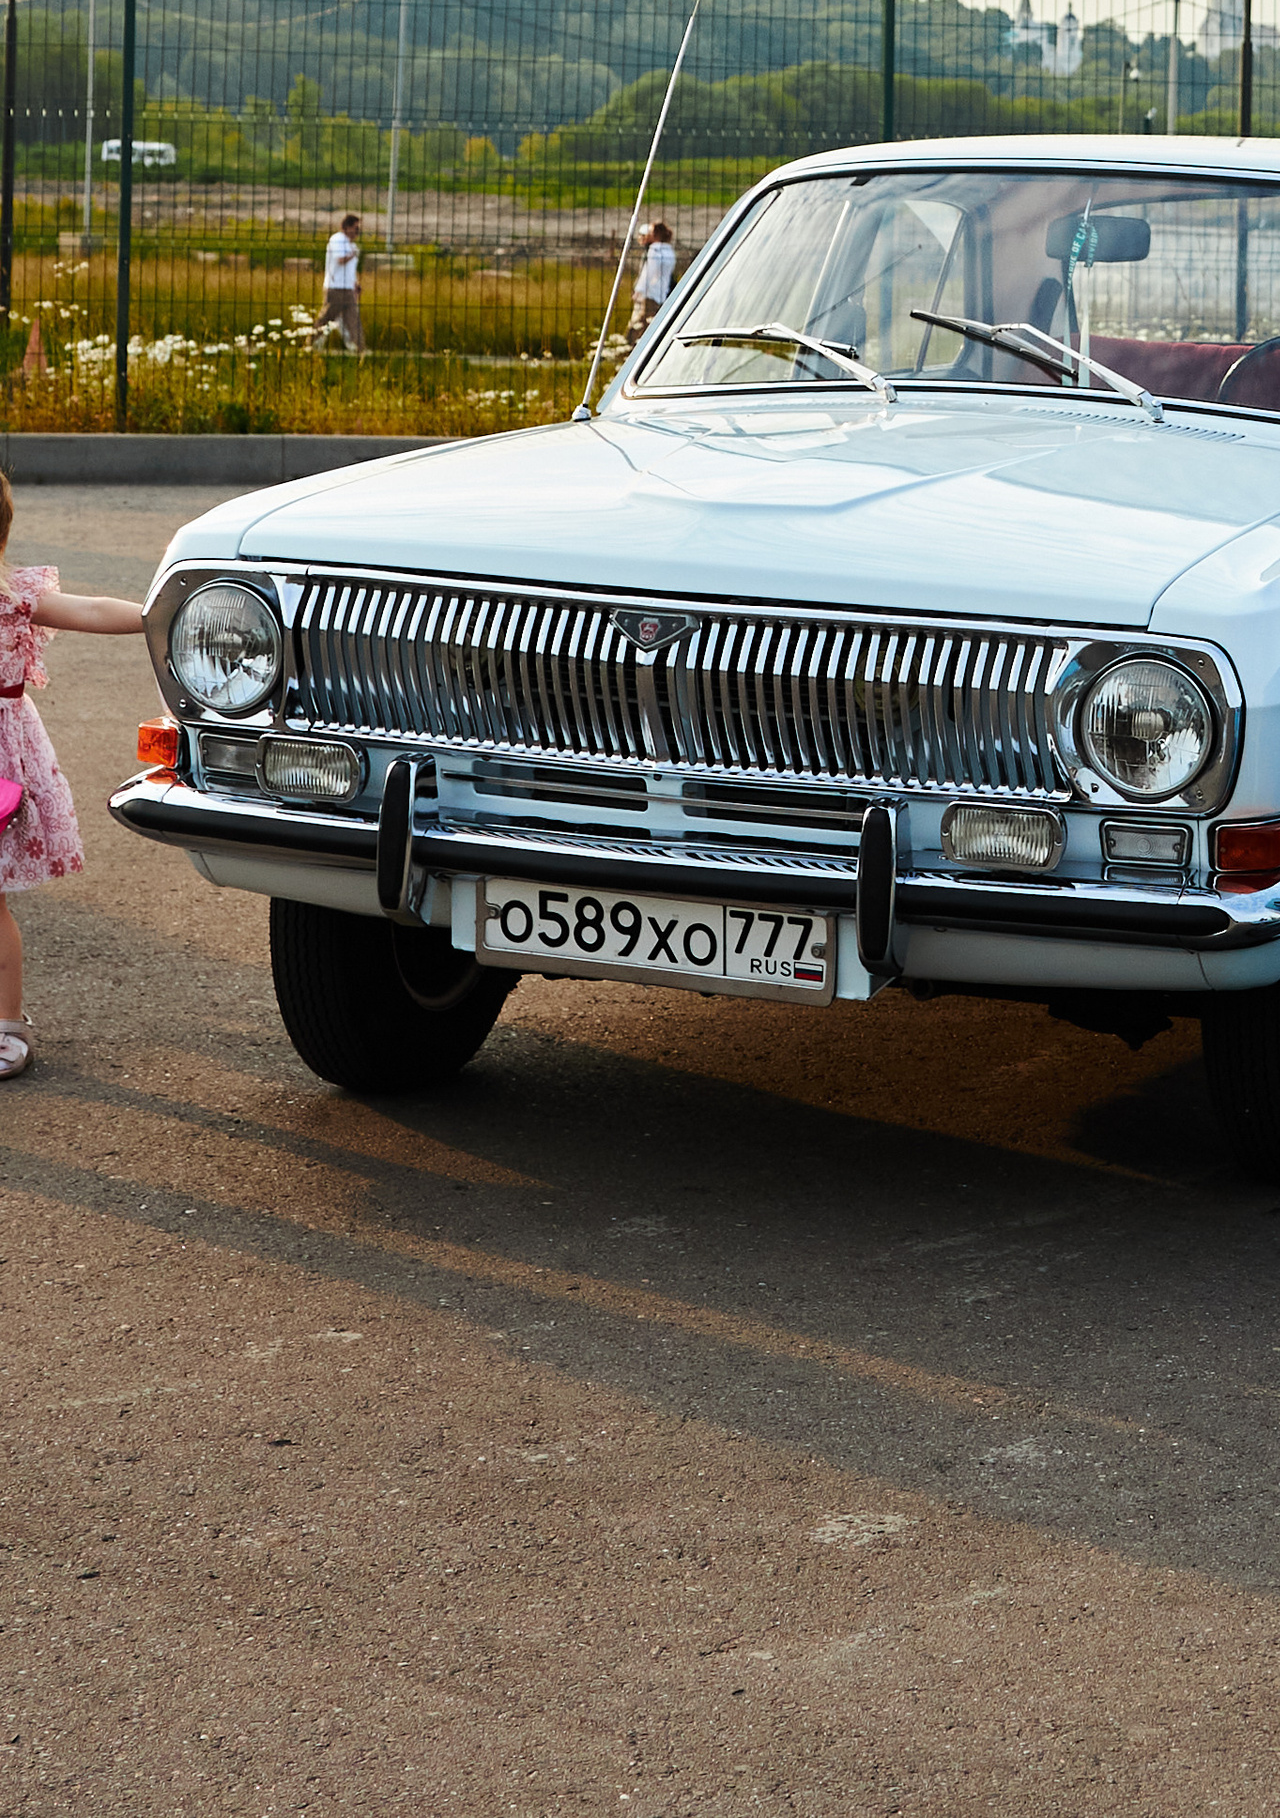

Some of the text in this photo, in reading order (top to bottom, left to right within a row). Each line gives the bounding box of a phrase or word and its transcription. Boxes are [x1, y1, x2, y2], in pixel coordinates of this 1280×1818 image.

[1071, 240, 1081, 253] OF
[729, 910, 813, 960] 777
[750, 958, 792, 977] RUS
